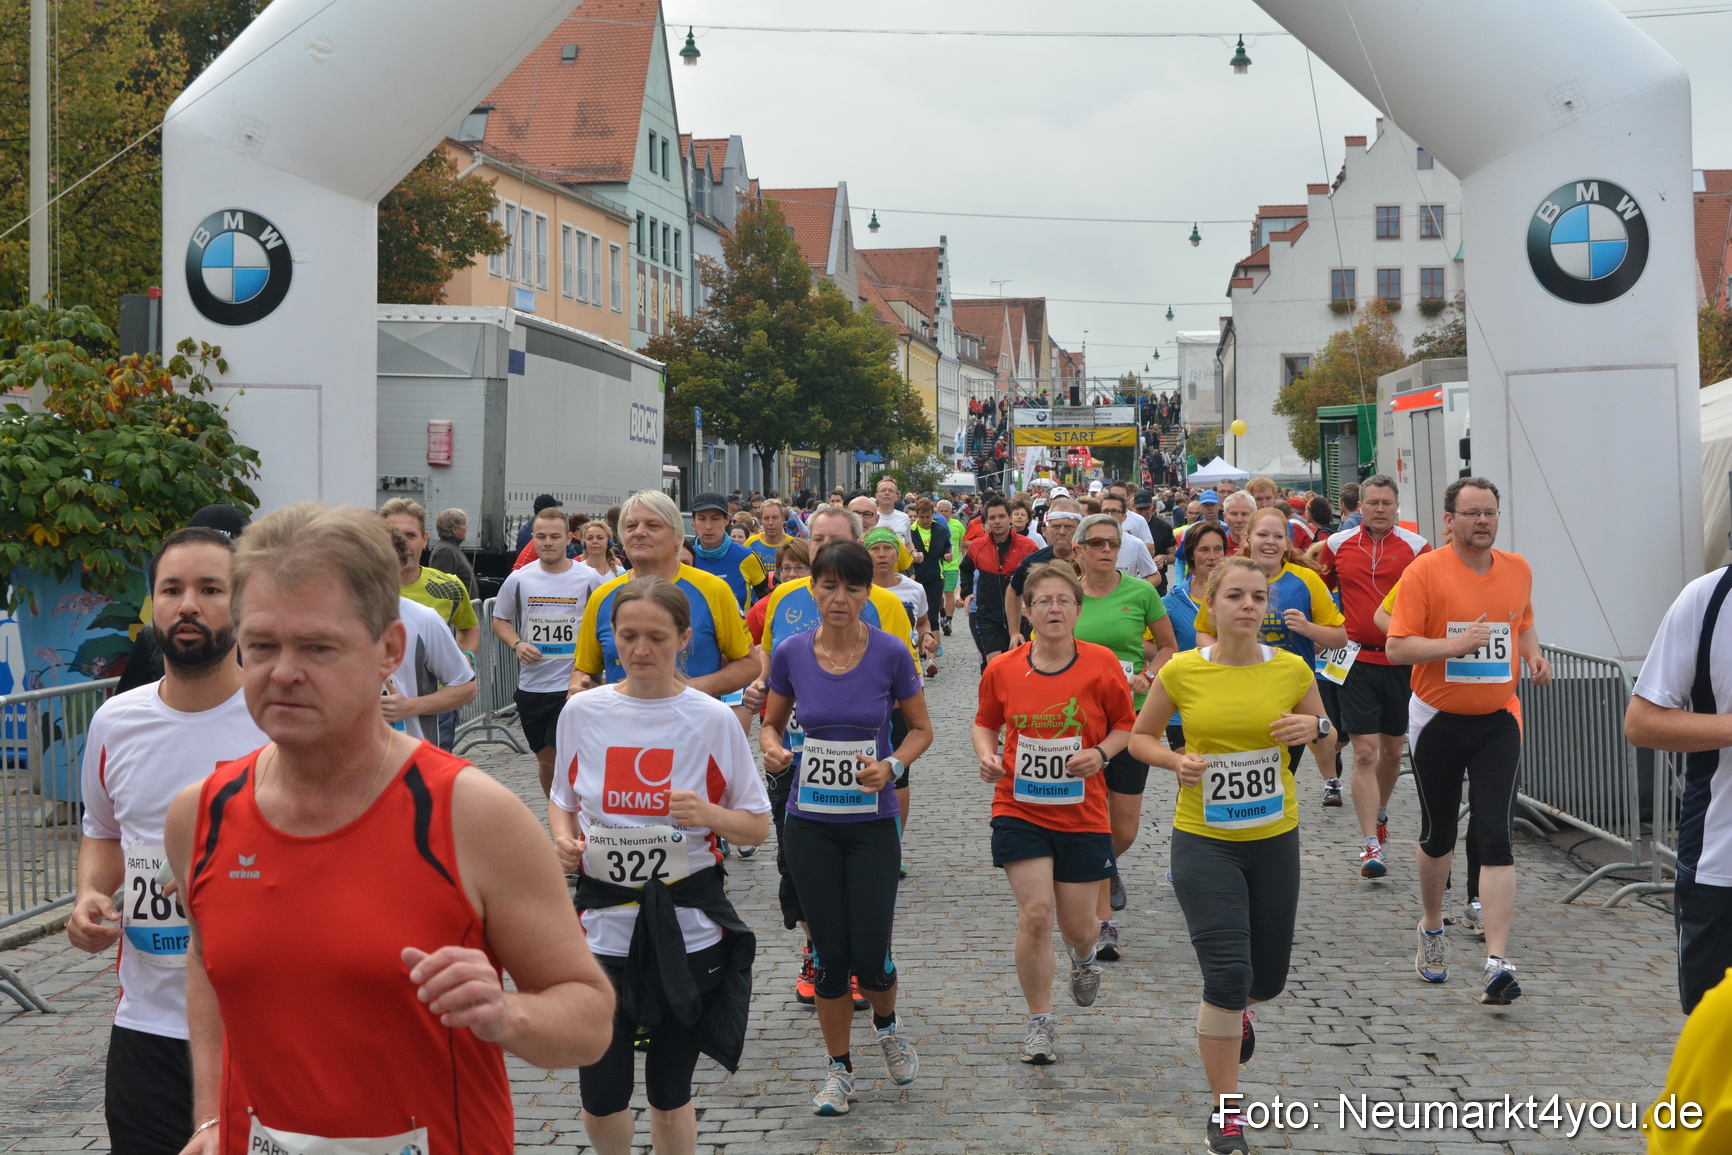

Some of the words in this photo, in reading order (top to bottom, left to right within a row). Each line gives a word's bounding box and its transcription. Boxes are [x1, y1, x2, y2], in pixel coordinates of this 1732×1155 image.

[1537, 182, 1640, 224] BMW
[192, 211, 284, 250] BMW
[630, 403, 658, 444] BOCK
[1053, 431, 1096, 442] START
[532, 625, 573, 642] 2146
[1030, 720, 1063, 729] FunRun
[804, 744, 825, 755] PARTL
[826, 748, 863, 756] Neumarkt
[1018, 740, 1037, 752] PARTL
[1038, 744, 1071, 752] Neumarkt
[1207, 761, 1229, 769] ARTL
[1230, 756, 1270, 768] Neumarkt
[1027, 783, 1069, 796] Christine
[1210, 766, 1276, 801] 2589
[607, 790, 665, 810] DKMS
[812, 790, 862, 803] Germaine
[1226, 805, 1267, 819] Yvonne
[589, 835, 618, 846] PARTL
[619, 835, 668, 846] Neumarkt
[128, 858, 151, 870] PARTL
[606, 847, 670, 883] 322
[229, 870, 260, 879] erima
